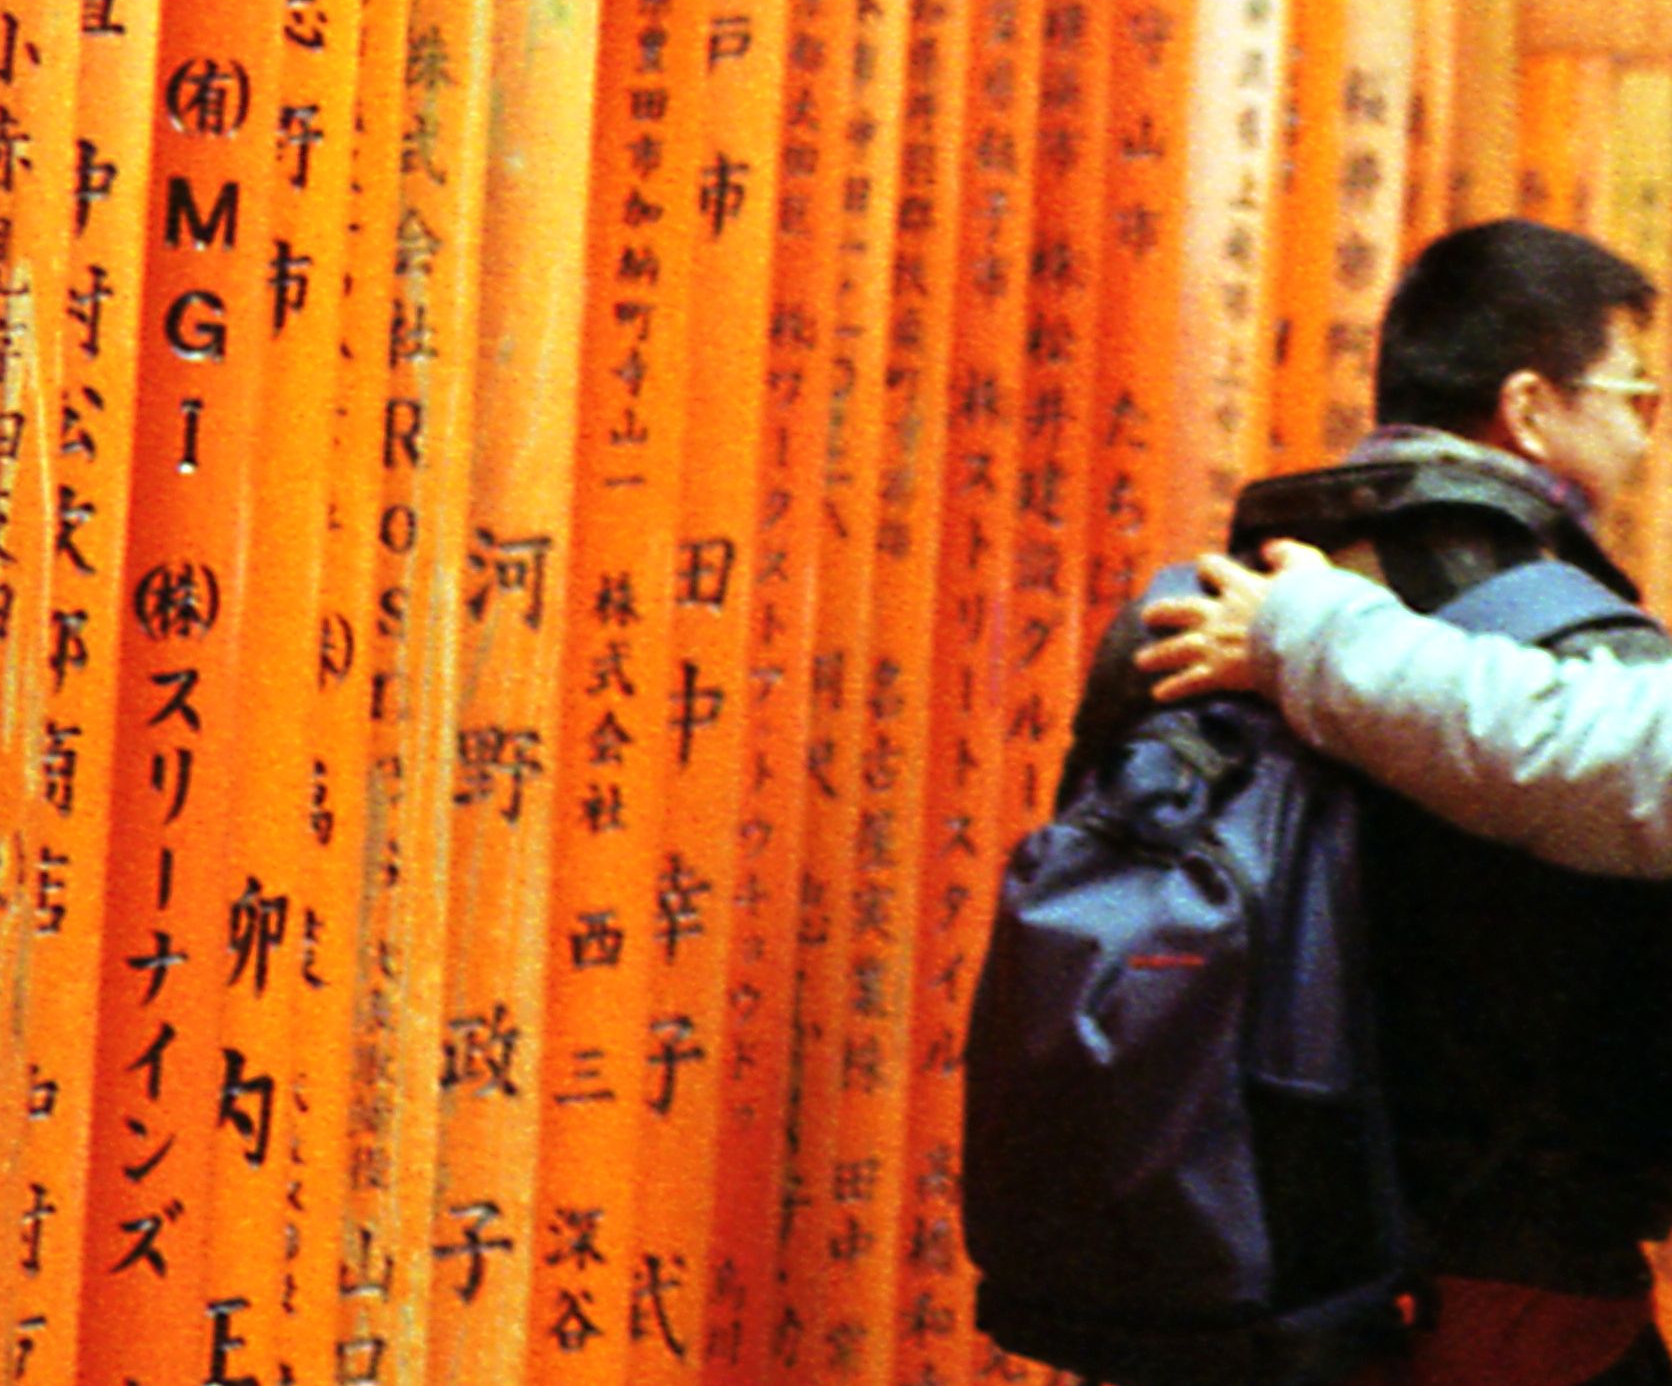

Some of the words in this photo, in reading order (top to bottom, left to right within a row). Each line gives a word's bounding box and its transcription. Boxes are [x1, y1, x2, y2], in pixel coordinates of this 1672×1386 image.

[439, 525, 554, 1306] 河野政子
[578, 569, 636, 835] 株式会社
[644, 533, 736, 1119] 田中幸子
